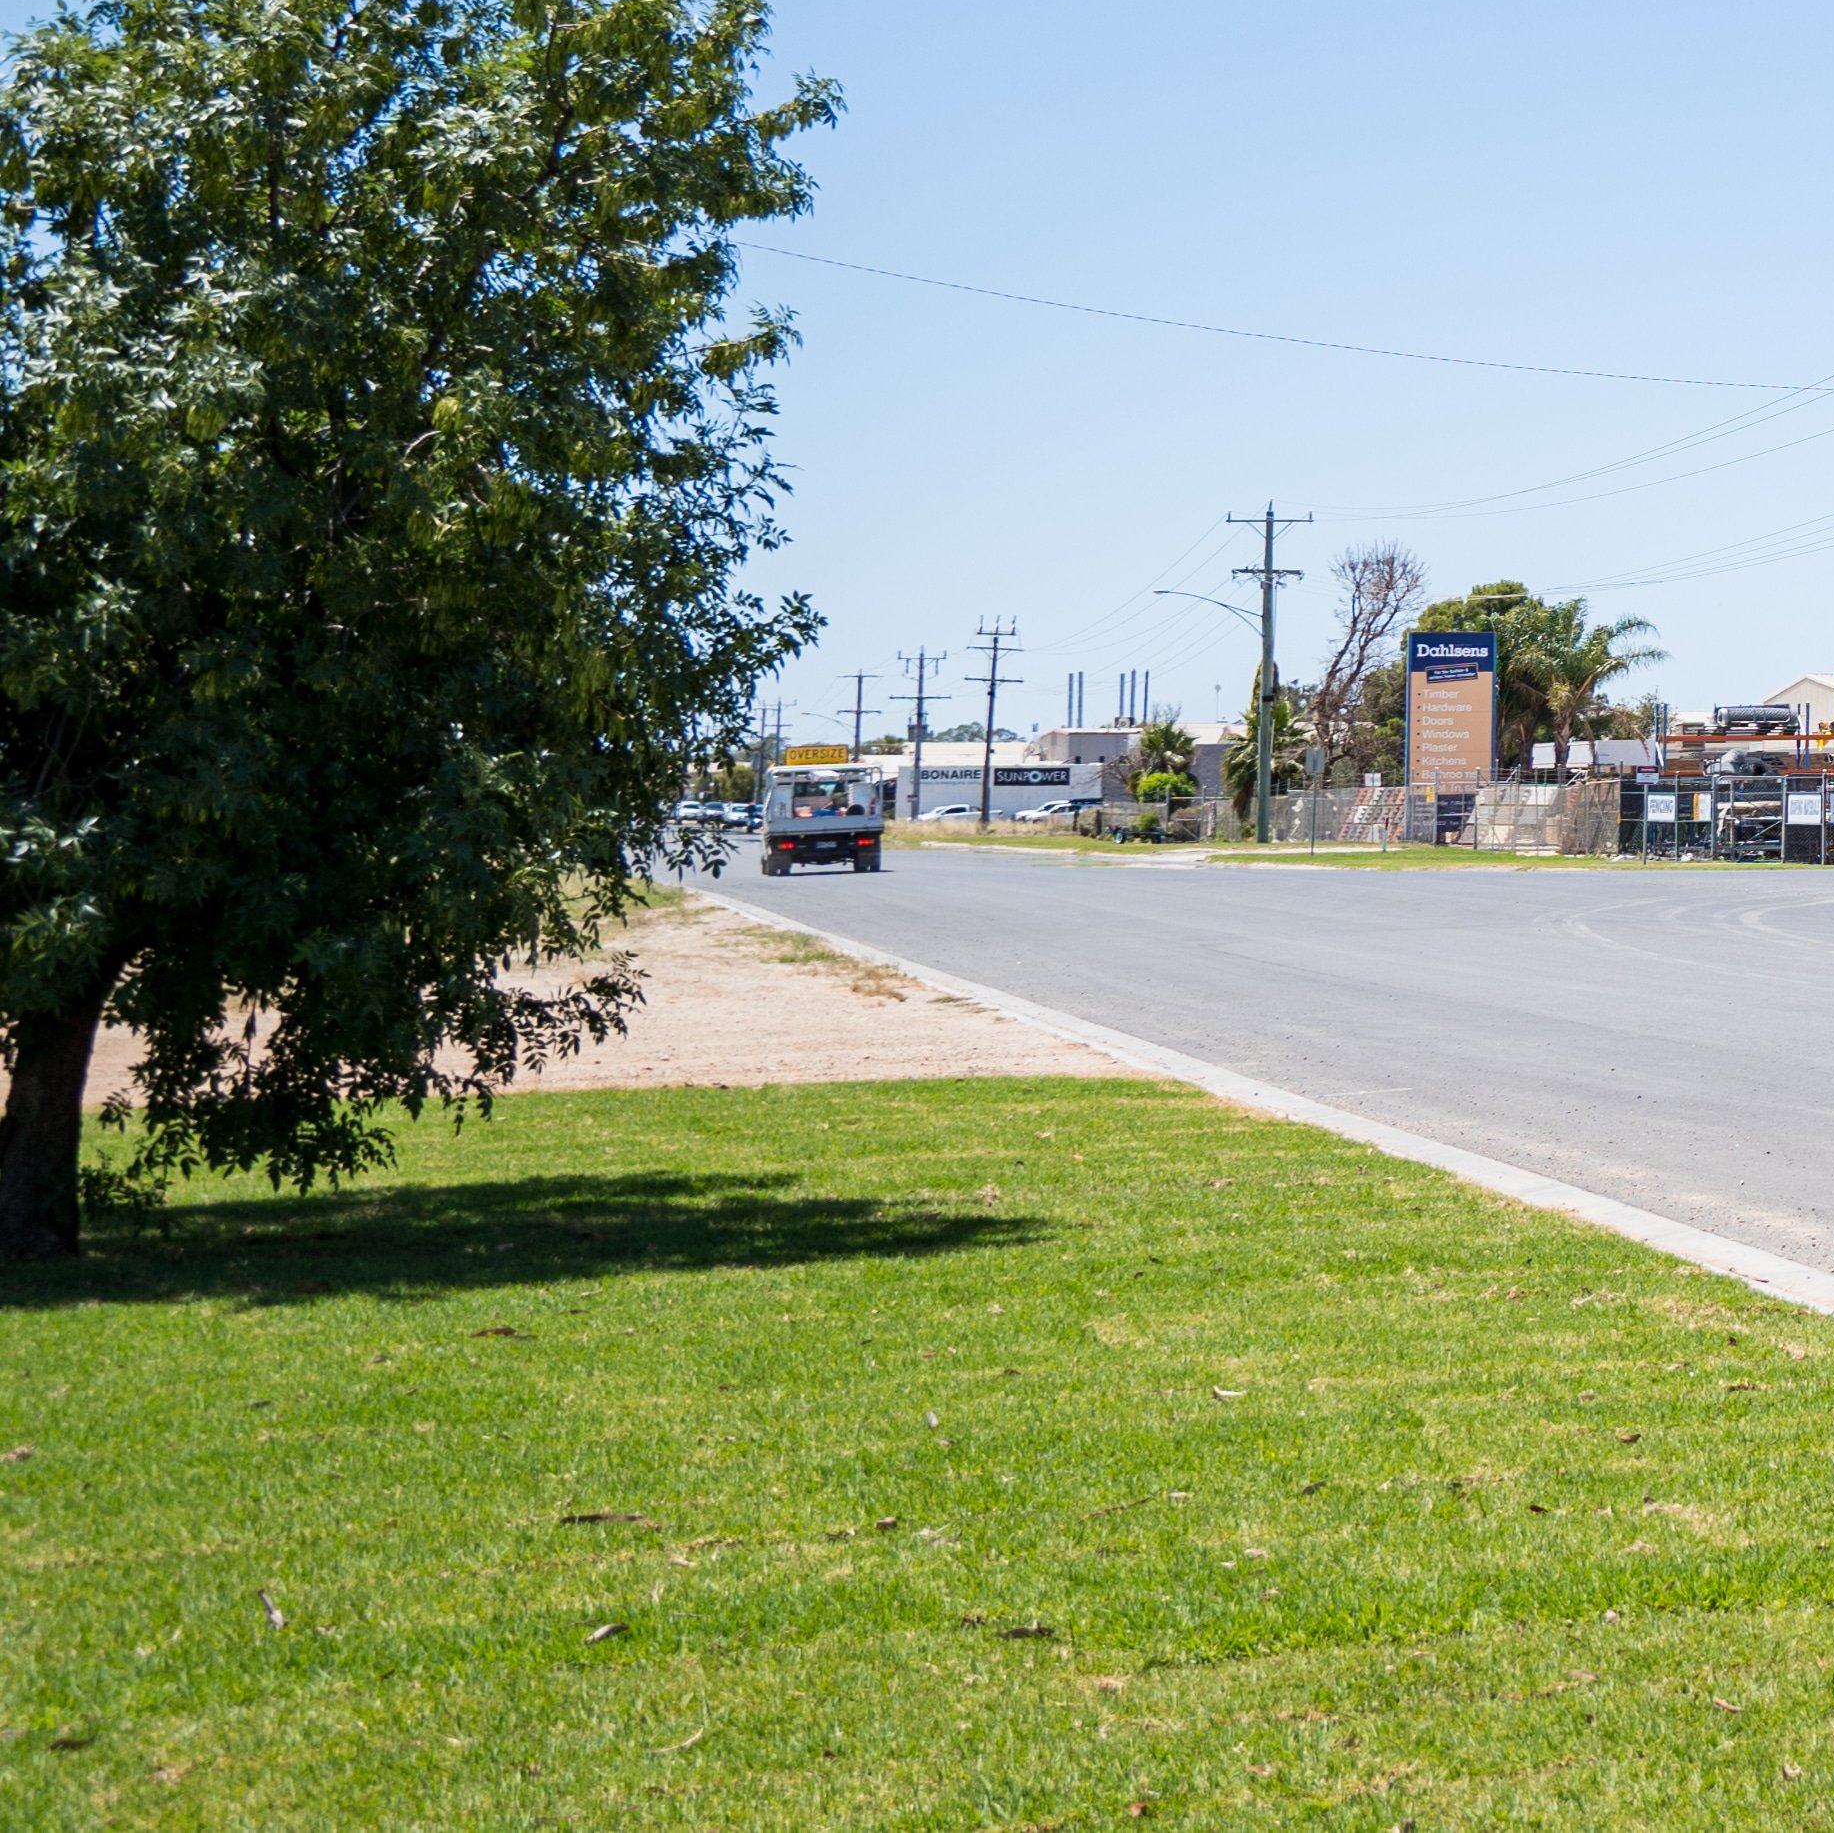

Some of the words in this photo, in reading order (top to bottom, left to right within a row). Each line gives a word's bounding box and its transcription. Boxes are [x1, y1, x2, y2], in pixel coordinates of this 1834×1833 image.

[1416, 643, 1489, 657] Dahlsens
[1422, 689, 1459, 699] Timber
[1422, 703, 1473, 712] Hardware
[1422, 716, 1454, 726] Doors
[1422, 730, 1470, 739] Windows
[1421, 743, 1458, 752] Plaster
[789, 748, 844, 760] OVERSIZE
[1421, 757, 1467, 766] Kitchens
[920, 769, 982, 780] BONAIRE
[996, 770, 1068, 783] SUNPOWER
